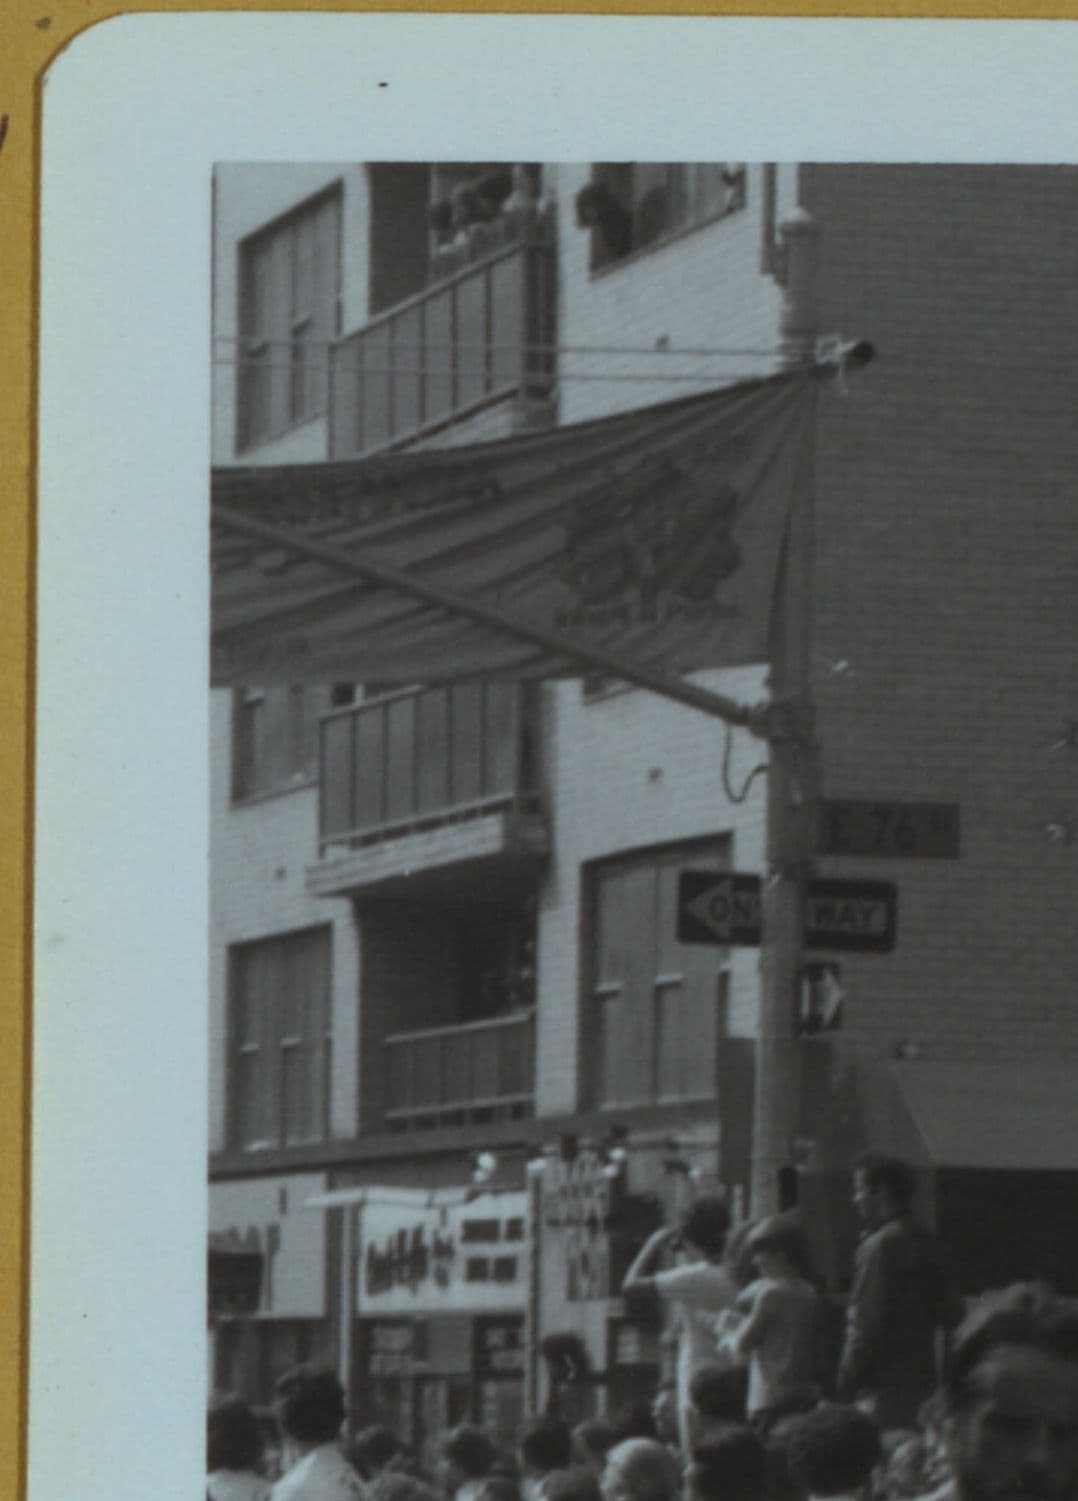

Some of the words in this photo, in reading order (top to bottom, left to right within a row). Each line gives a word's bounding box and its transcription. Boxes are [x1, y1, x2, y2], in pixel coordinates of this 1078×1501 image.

[829, 808, 849, 848] E
[868, 806, 917, 849] 76
[814, 902, 876, 929] WAY
